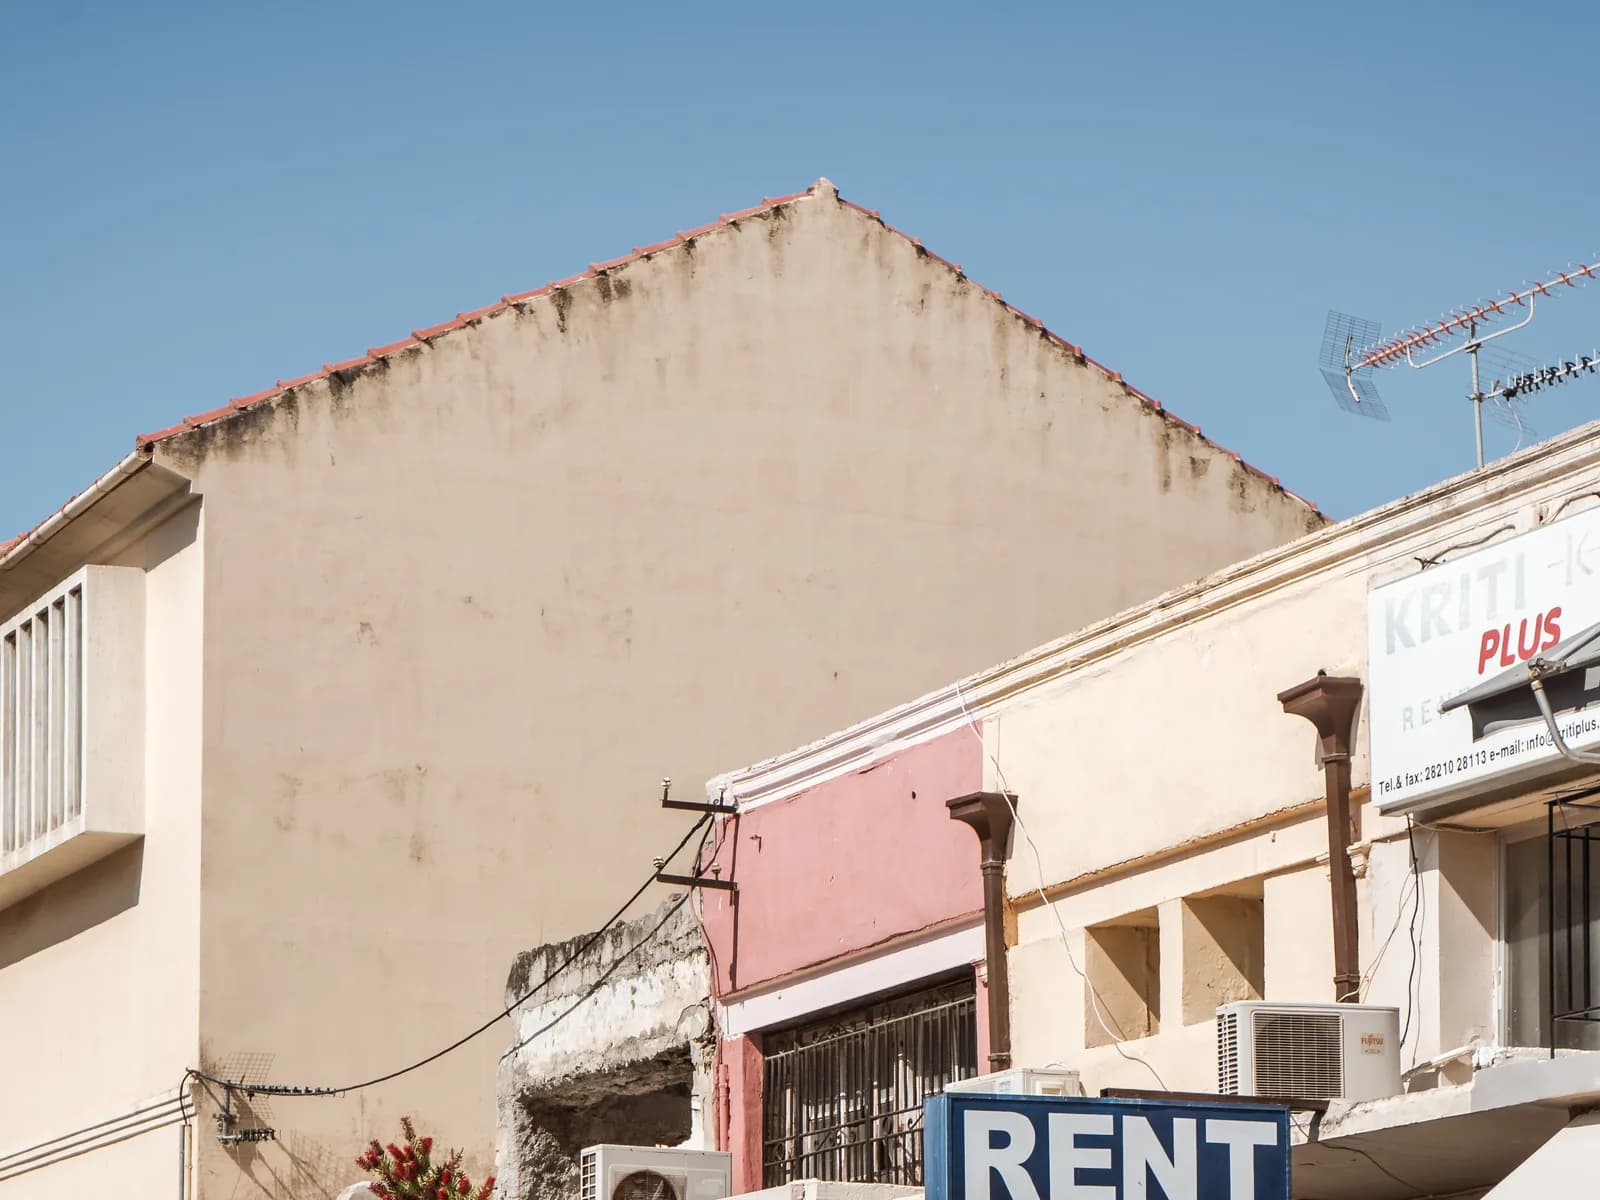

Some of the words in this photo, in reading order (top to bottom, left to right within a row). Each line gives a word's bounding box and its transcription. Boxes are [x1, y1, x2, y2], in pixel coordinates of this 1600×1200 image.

[1386, 552, 1525, 655] KRITI
[1478, 606, 1562, 675] PLUS
[1425, 761, 1455, 780] 28210
[1456, 750, 1487, 771] 28113
[1489, 739, 1525, 762] e-mail:
